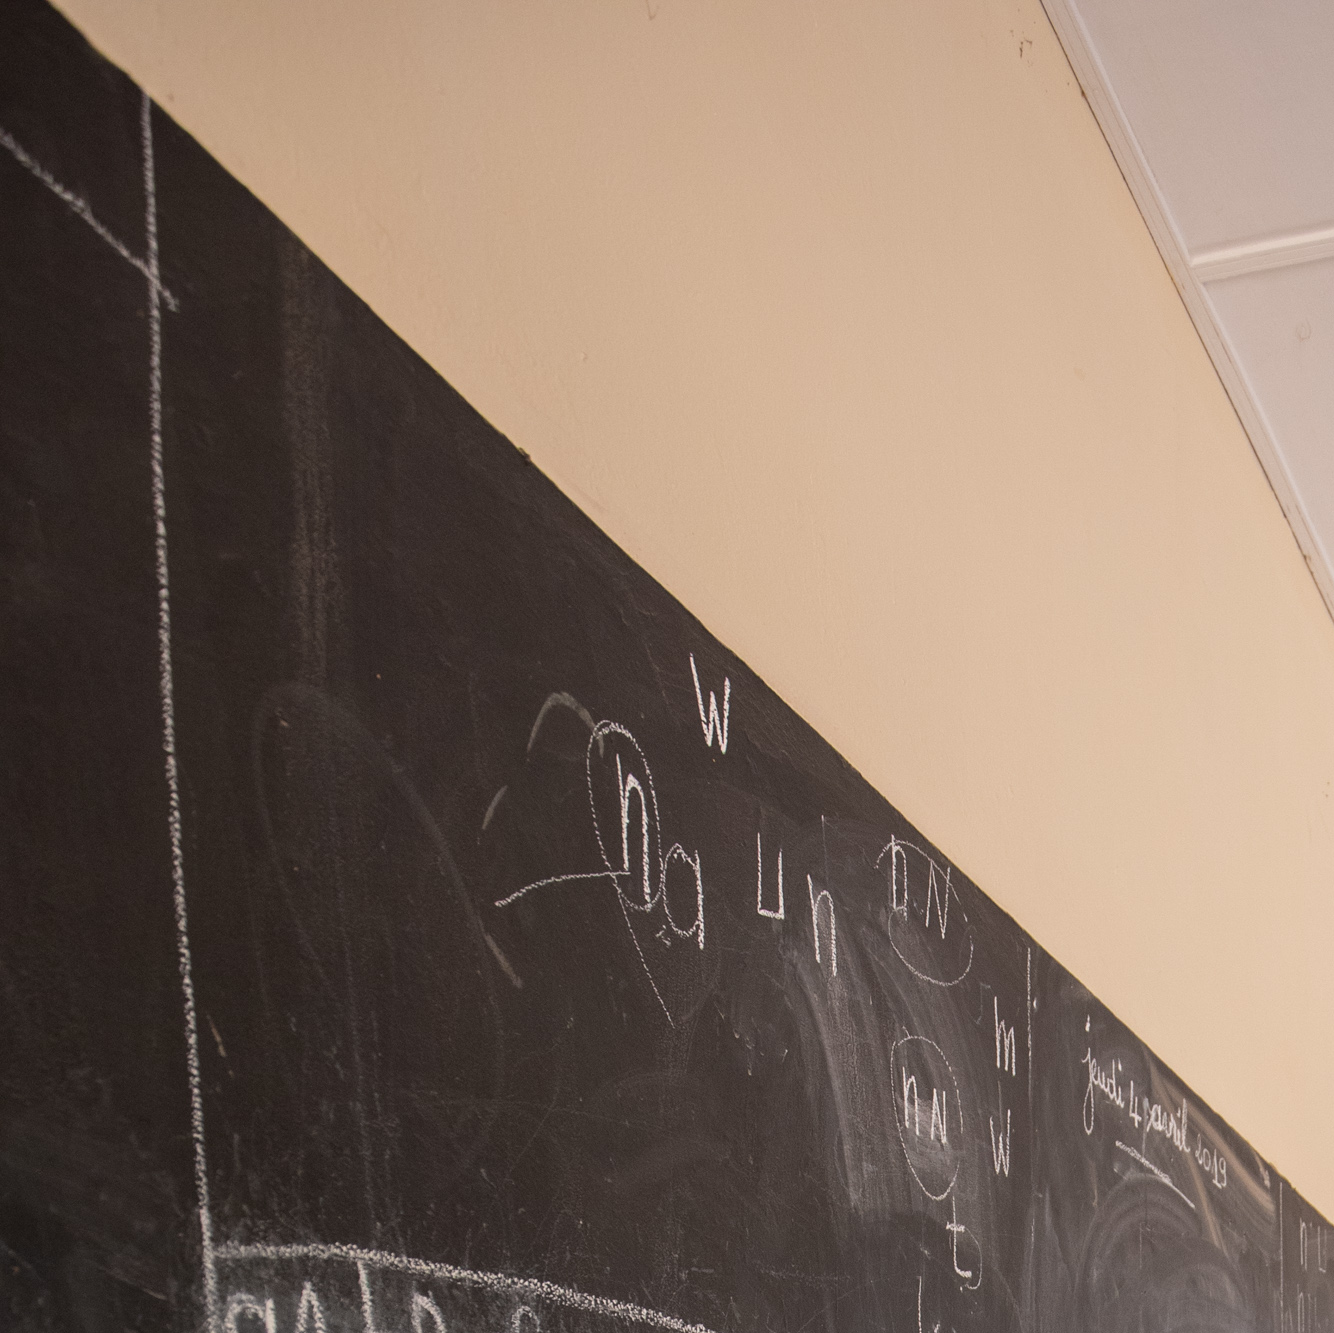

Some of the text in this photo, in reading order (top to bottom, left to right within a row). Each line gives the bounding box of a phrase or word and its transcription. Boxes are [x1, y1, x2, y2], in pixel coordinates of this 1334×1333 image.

[1081, 1014, 1227, 1190] jeudi 4 avril 2019
